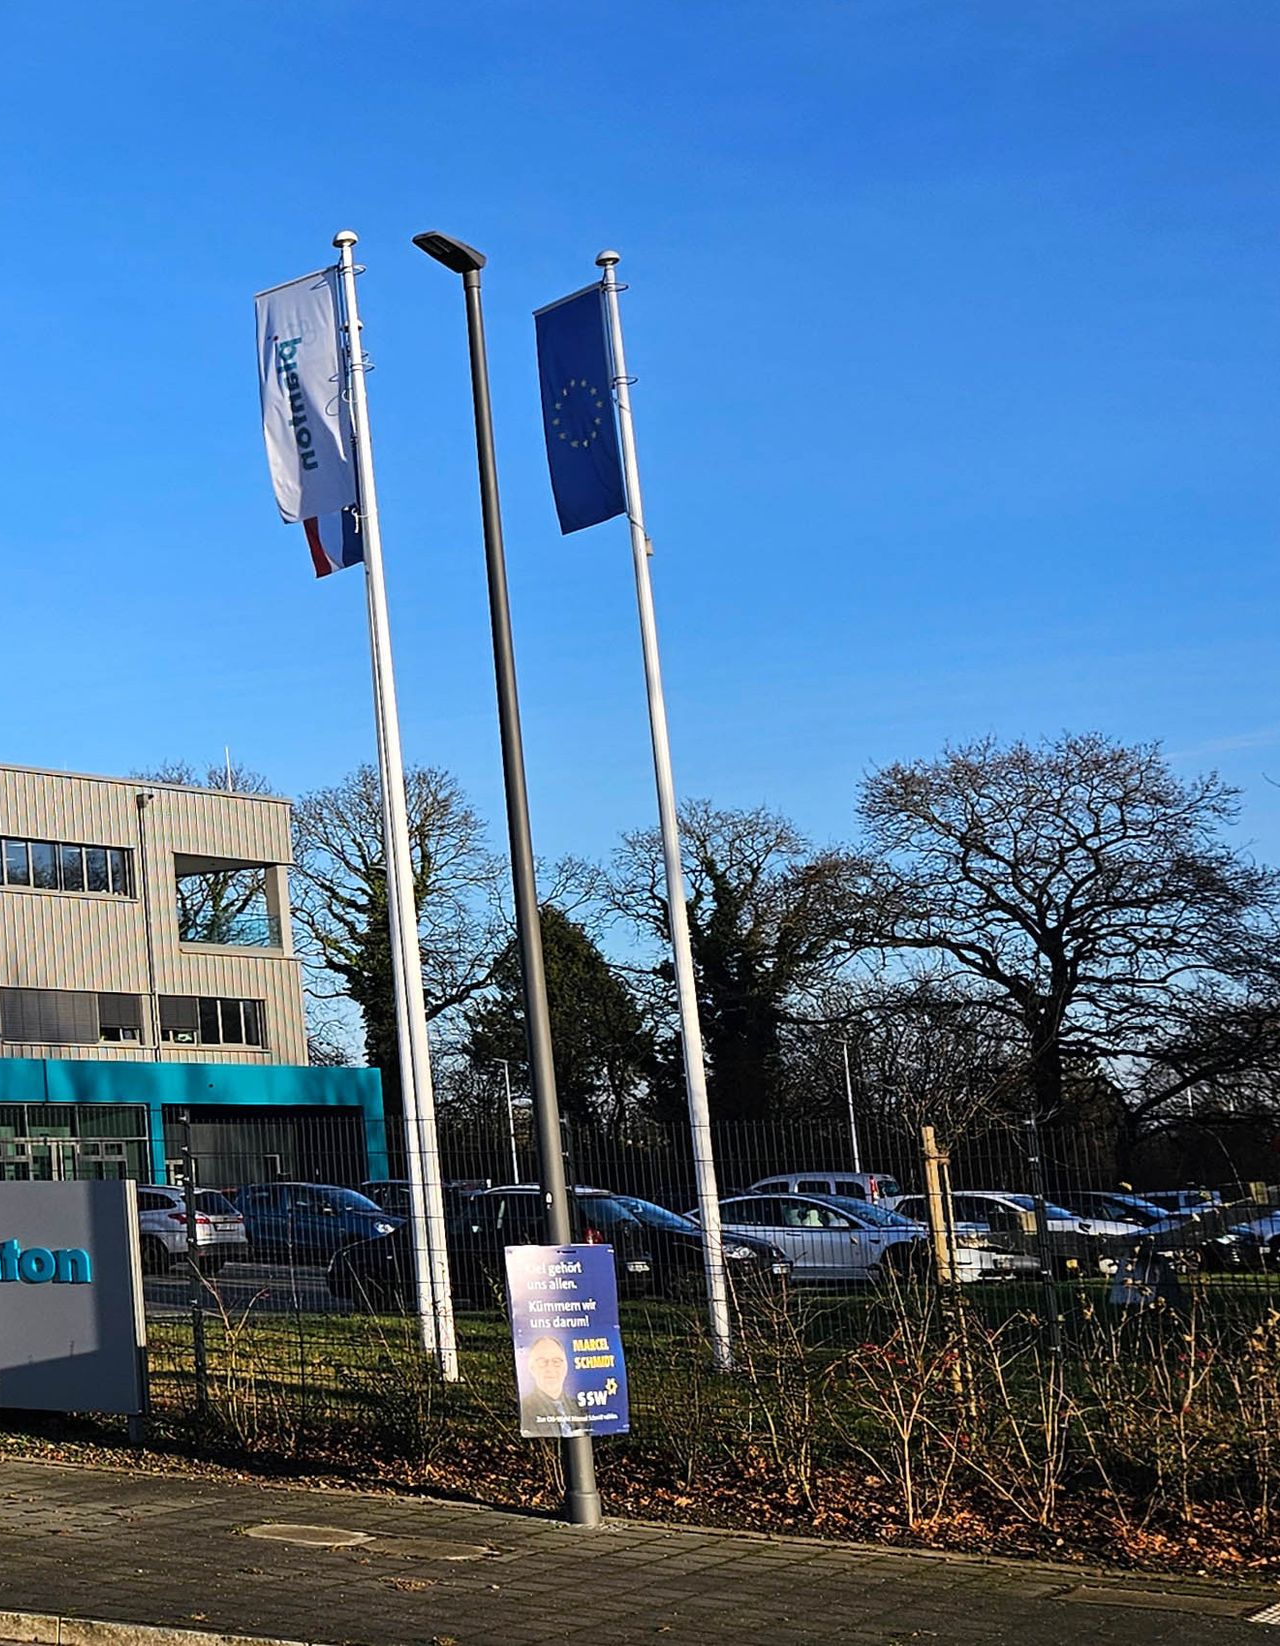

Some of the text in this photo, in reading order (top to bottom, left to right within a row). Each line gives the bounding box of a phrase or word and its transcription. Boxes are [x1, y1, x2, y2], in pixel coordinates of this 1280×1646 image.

[548, 1262, 583, 1277] gehört
[528, 1278, 578, 1290] uns allen.
[528, 1298, 597, 1313] Kümmern wir
[530, 1315, 590, 1329] uns darum!
[573, 1338, 610, 1352] MARCEL
[577, 1390, 608, 1407] SSW
